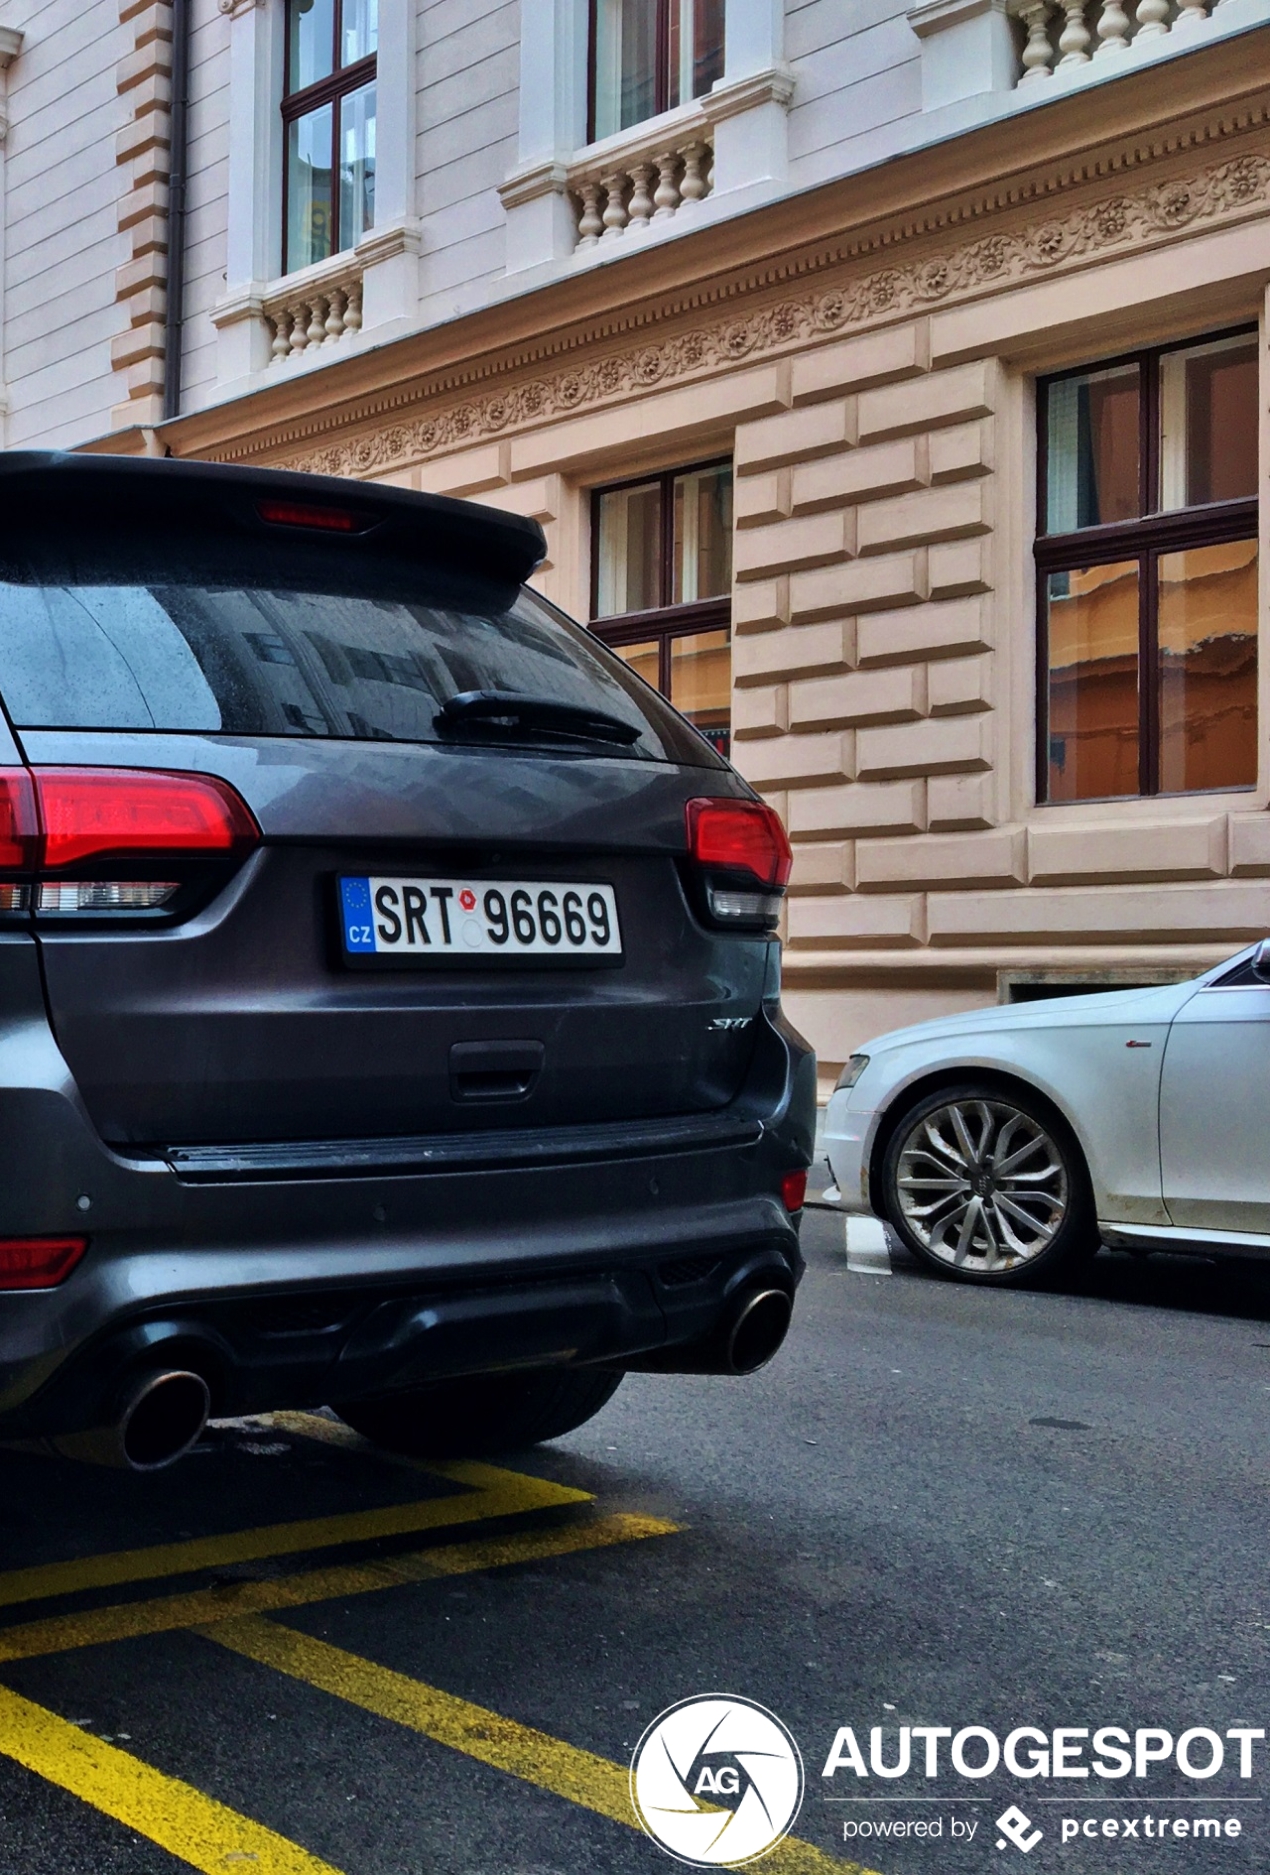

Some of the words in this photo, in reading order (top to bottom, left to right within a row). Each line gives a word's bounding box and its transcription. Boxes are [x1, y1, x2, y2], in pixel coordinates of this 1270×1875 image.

[375, 886, 454, 944] SRT
[484, 889, 610, 946] 96669
[349, 926, 372, 943] CZ
[708, 1017, 753, 1031] SRT
